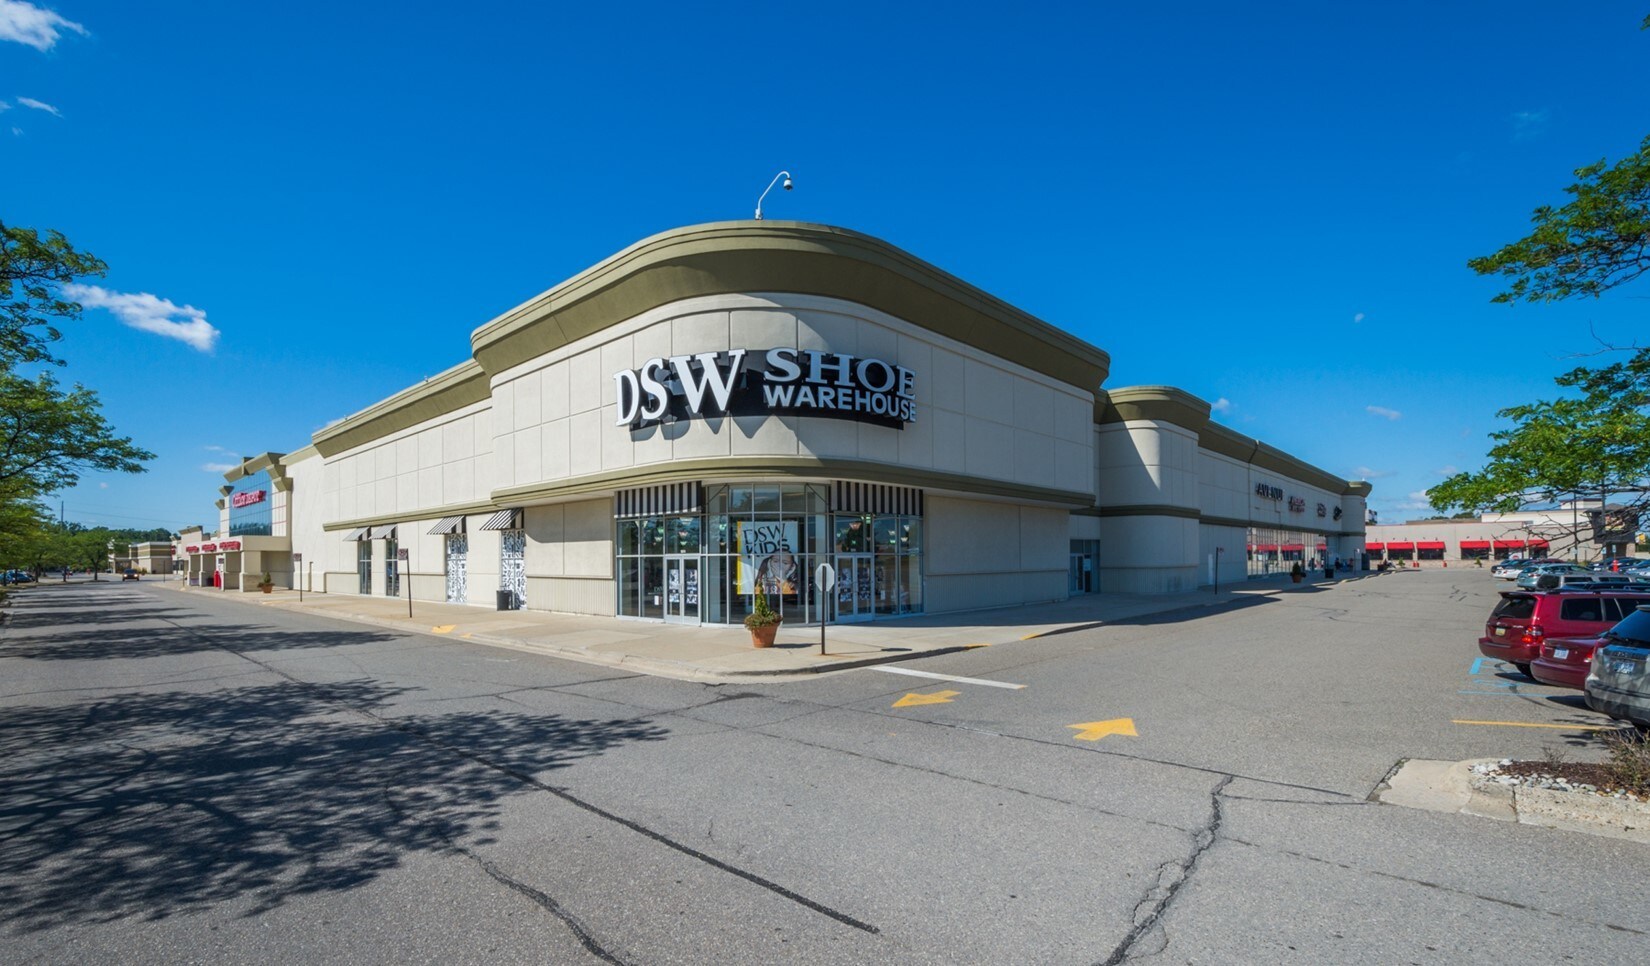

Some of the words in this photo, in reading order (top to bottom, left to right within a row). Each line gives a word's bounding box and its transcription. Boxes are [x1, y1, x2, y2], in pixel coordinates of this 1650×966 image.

[613, 349, 746, 427] DSW
[763, 347, 916, 400] SHOE
[763, 385, 916, 423] WAREHOUSE
[743, 523, 785, 545] DSW
[746, 539, 791, 559] KIDS
